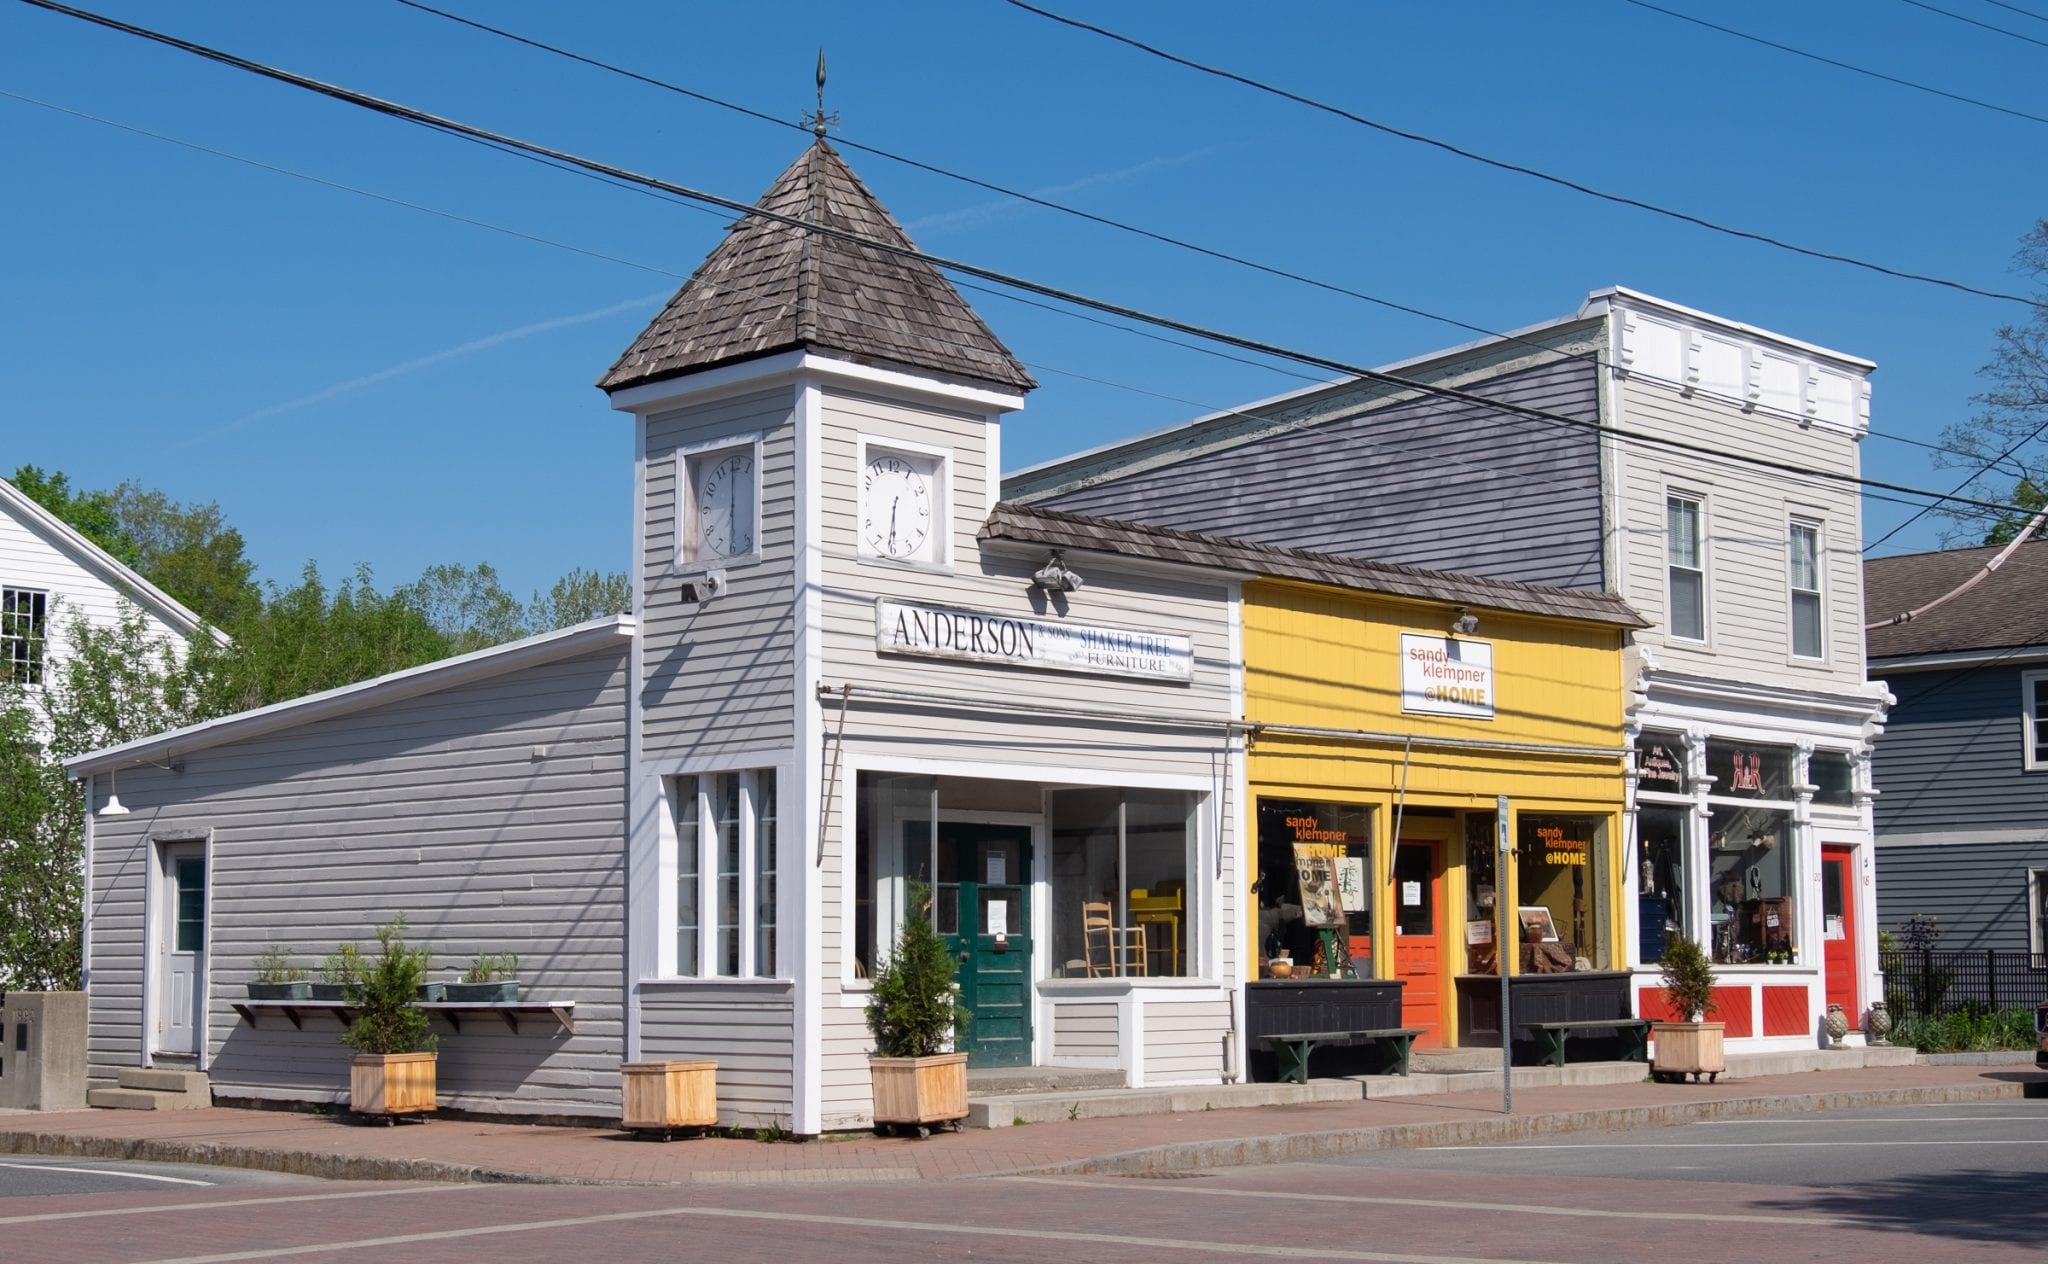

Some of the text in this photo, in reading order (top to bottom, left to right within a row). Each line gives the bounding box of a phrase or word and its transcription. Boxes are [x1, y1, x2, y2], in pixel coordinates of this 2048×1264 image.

[716, 466, 726, 480] 11
[873, 461, 884, 476] 11
[888, 460, 900, 474] 12
[905, 470, 912, 480] 1
[706, 482, 716, 498] 10
[915, 486, 925, 497] 2
[702, 506, 712, 516] 9
[919, 507, 928, 518] 3
[706, 525, 714, 536] 8
[916, 528, 924, 538] 4
[716, 537, 724, 549] 7
[874, 534, 883, 546] 7
[905, 540, 912, 552] 5
[730, 541, 736, 554] 6
[890, 543, 896, 556] 6
[894, 608, 1036, 658] ANDERSON
[1080, 629, 1133, 654] SHAKER
[1139, 636, 1172, 657] TREE
[1088, 652, 1166, 672] FURNITURE
[1410, 648, 1450, 666] sandy
[1424, 662, 1485, 684] klempner
[1424, 685, 1486, 706] @HOME
[1286, 816, 1318, 829] sandy
[1296, 827, 1346, 842] klempner
[1537, 827, 1563, 840] sandy
[1546, 836, 1586, 851] klempner
[1546, 852, 1586, 865] @HOME
